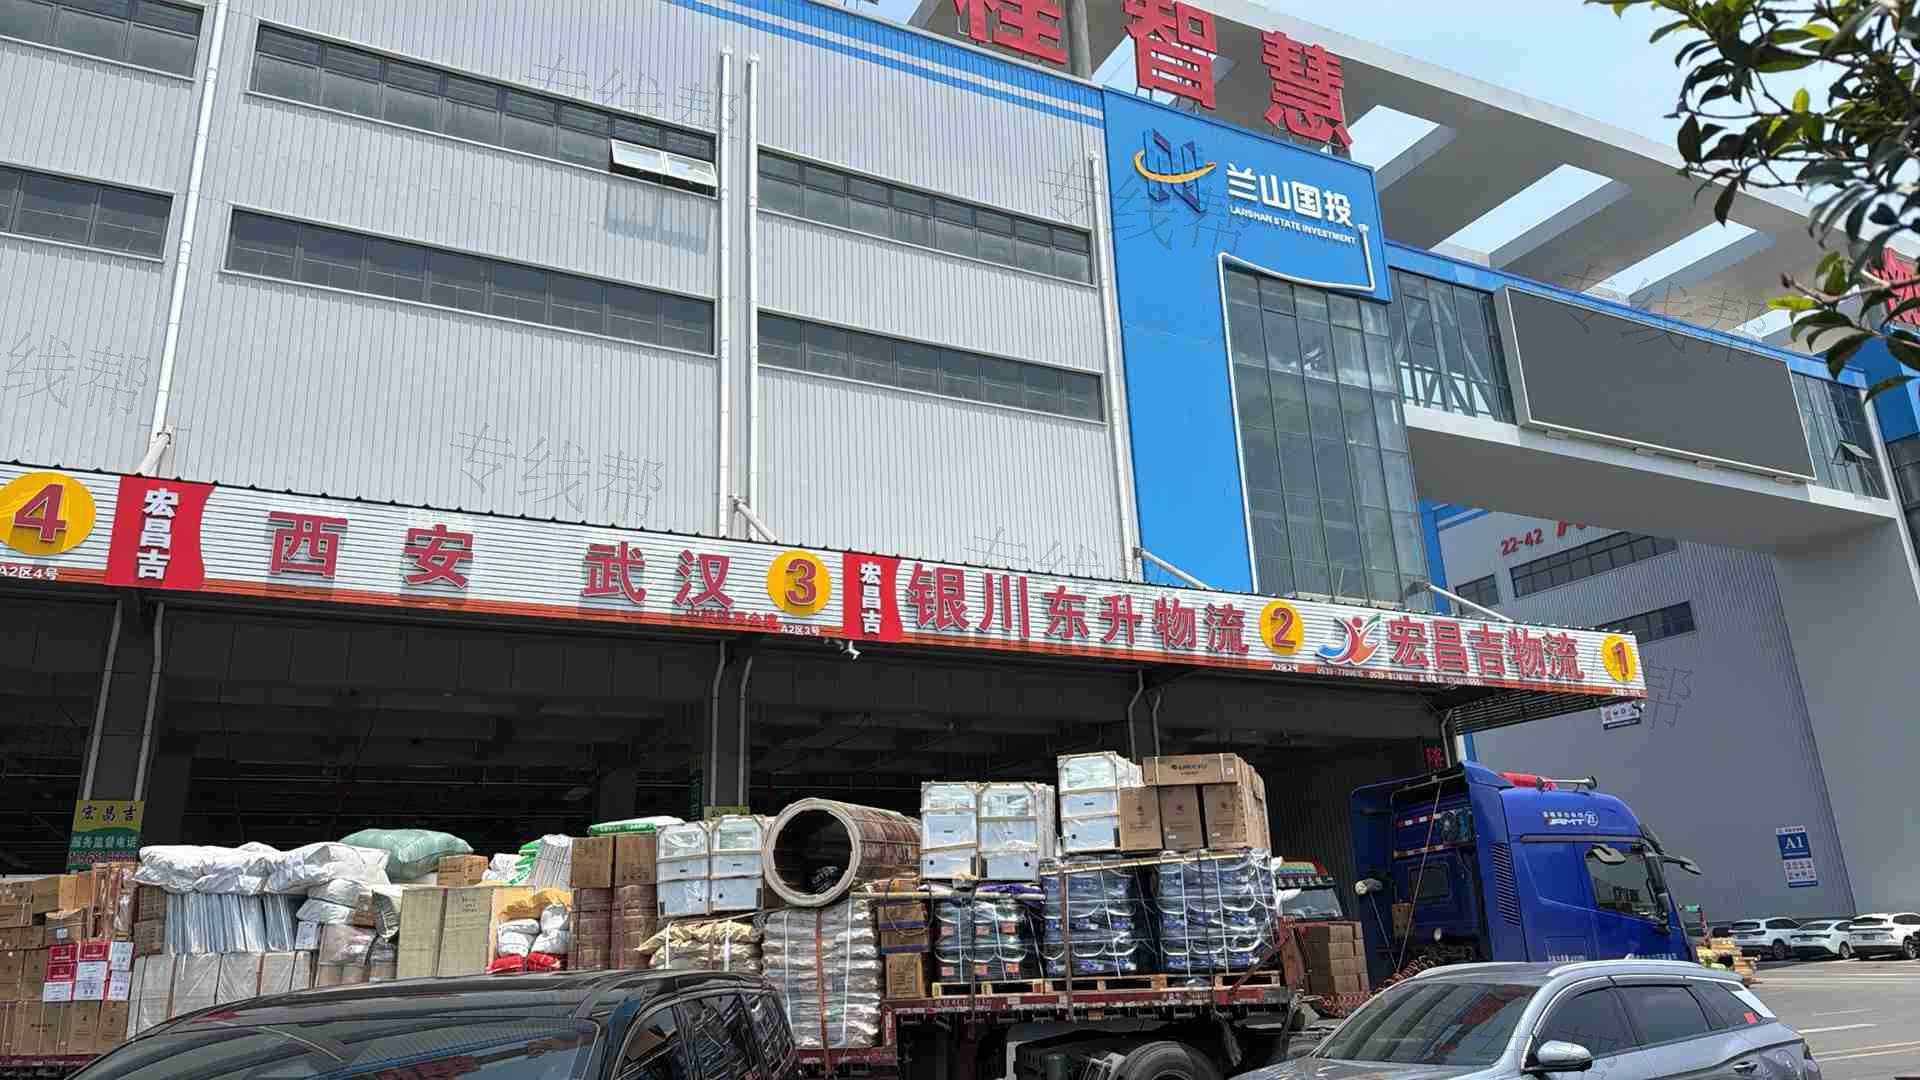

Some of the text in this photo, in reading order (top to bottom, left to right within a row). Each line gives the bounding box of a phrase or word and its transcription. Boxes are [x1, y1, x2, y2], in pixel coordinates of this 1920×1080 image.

[1227, 162, 1353, 227] 兰山国投
[1274, 215, 1301, 232] STATE
[1302, 224, 1358, 245] INVESTMENT
[14, 484, 67, 542] 4
[137, 488, 179, 580] 宏昌吉
[785, 558, 817, 606] 3
[858, 560, 882, 635] 宏昌吉
[908, 563, 1250, 654] 银川东升物流
[1271, 607, 1297, 648] 2
[1388, 616, 1585, 681] 宏昌吉物流
[1613, 641, 1630, 678] 1
[81, 804, 138, 822] 宏昌吉
[1785, 836, 1804, 849] A1
